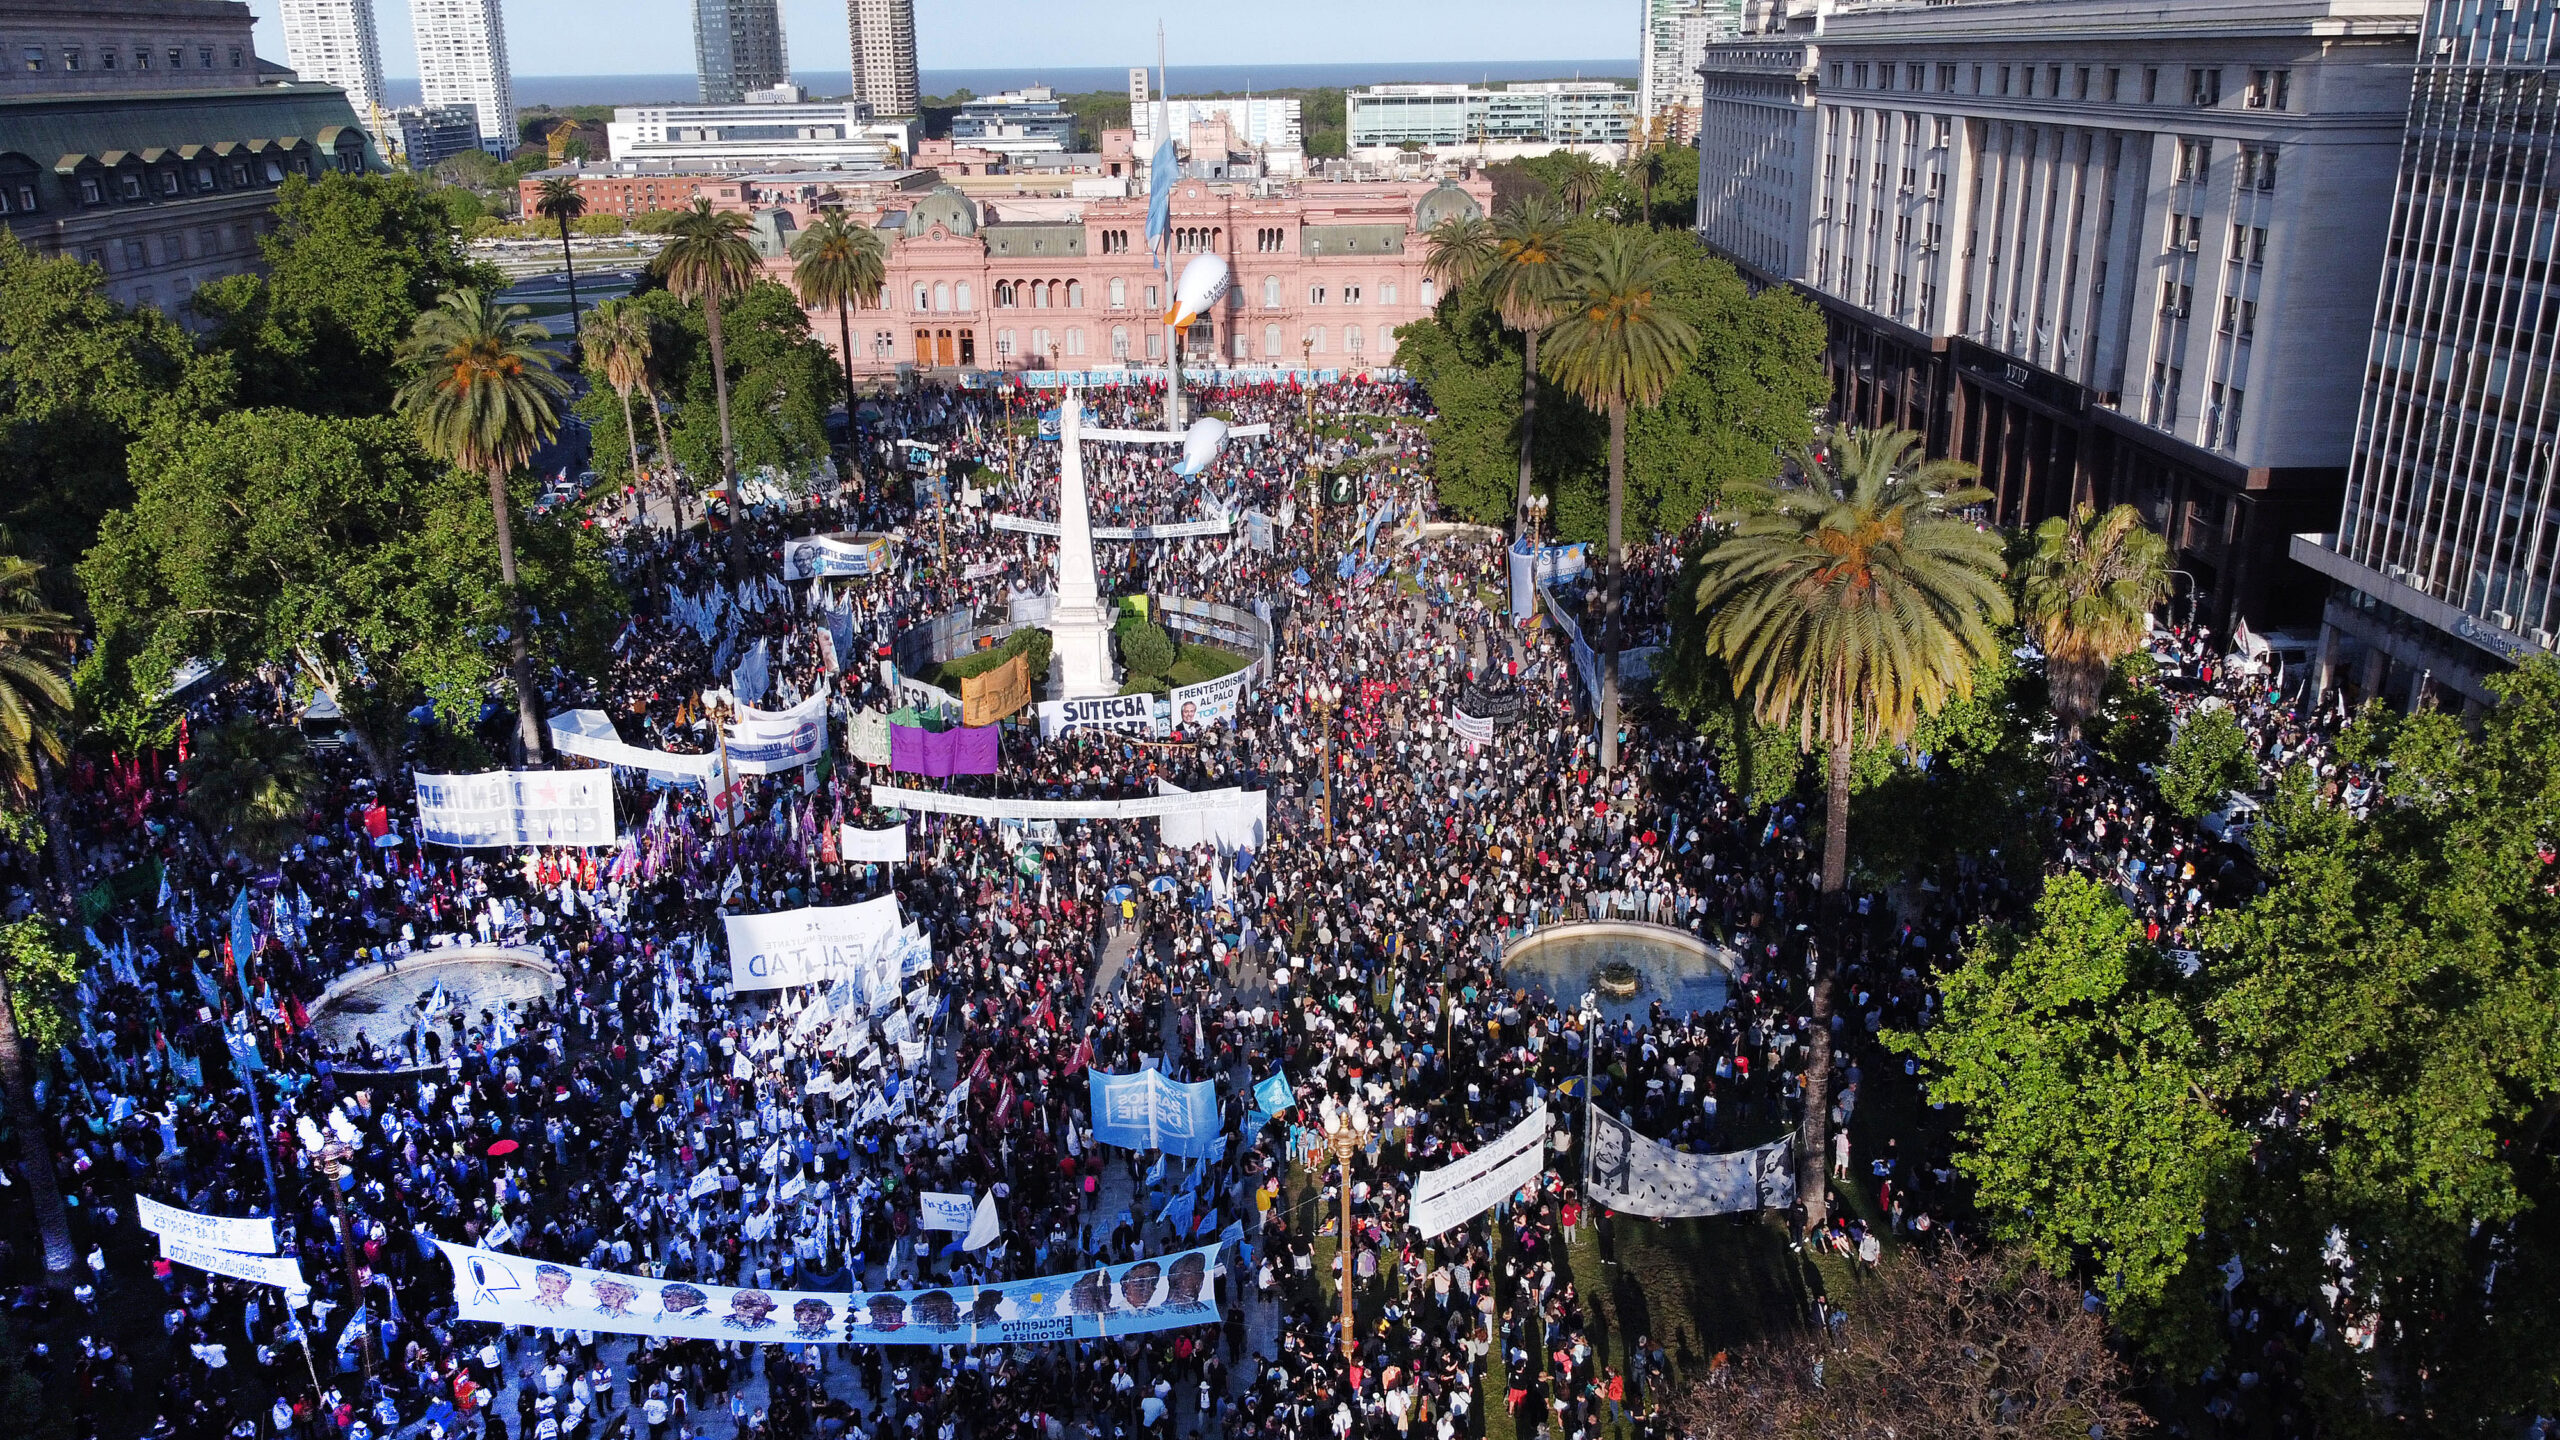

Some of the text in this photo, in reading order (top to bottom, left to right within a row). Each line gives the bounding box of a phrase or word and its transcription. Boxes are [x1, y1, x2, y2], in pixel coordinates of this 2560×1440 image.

[757, 91, 787, 101] Hilton
[1199, 689, 1235, 706] AL PALO
[1063, 695, 1147, 722] SUTECBA
